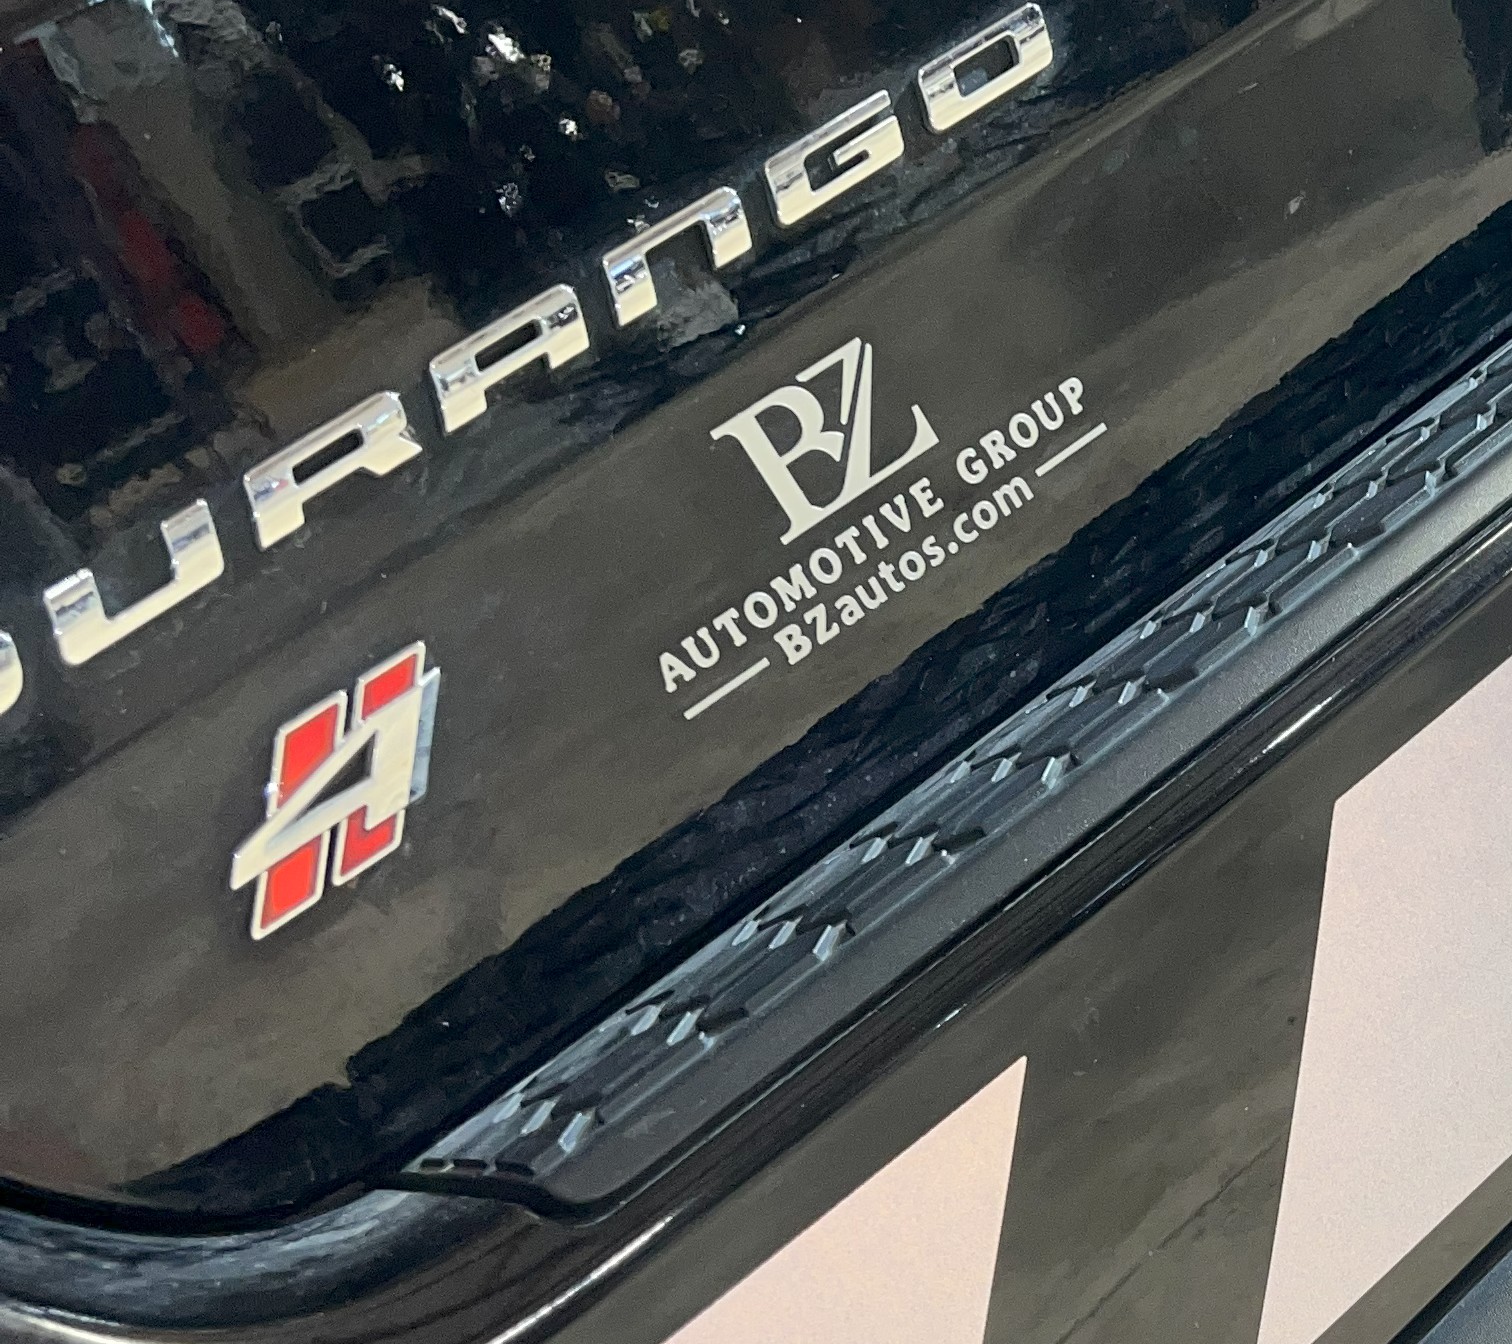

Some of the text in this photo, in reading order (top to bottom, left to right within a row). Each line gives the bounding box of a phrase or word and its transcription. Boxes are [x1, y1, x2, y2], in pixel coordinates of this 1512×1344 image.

[0, 1, 1055, 715] URANGO
[709, 337, 940, 546] BZ
[659, 377, 1085, 693] AUTOMOTIVE GROUP
[773, 476, 1035, 666] BZautos.com
